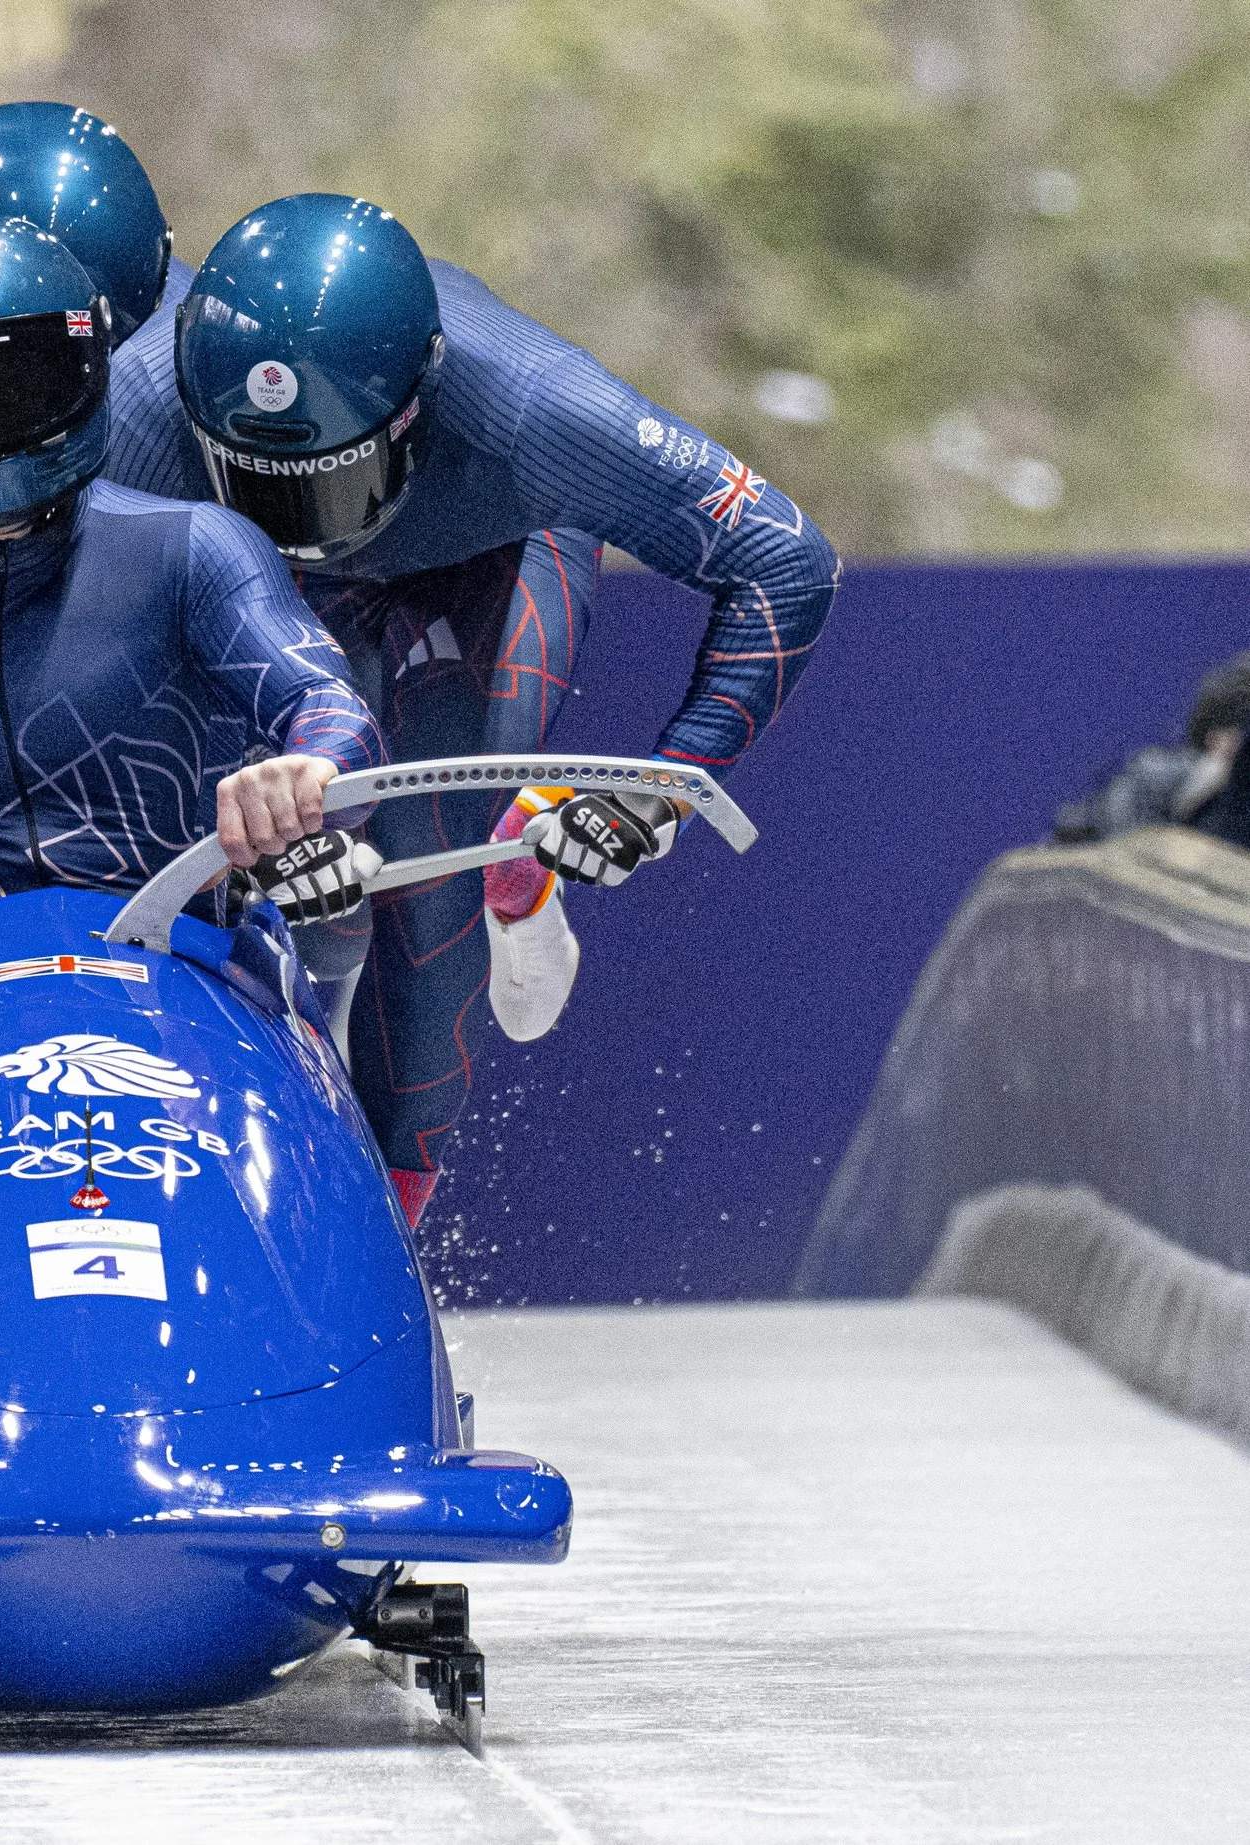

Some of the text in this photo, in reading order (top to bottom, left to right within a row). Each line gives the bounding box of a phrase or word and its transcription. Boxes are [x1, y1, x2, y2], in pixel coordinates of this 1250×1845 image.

[257, 386, 286, 396] TEAM GB
[205, 436, 377, 477] GREENWOOD
[657, 438, 676, 467] TEAM
[573, 807, 624, 859] SEIZ
[275, 836, 334, 877] SEIZ
[139, 1117, 231, 1156] GB
[73, 1254, 126, 1280] 4
